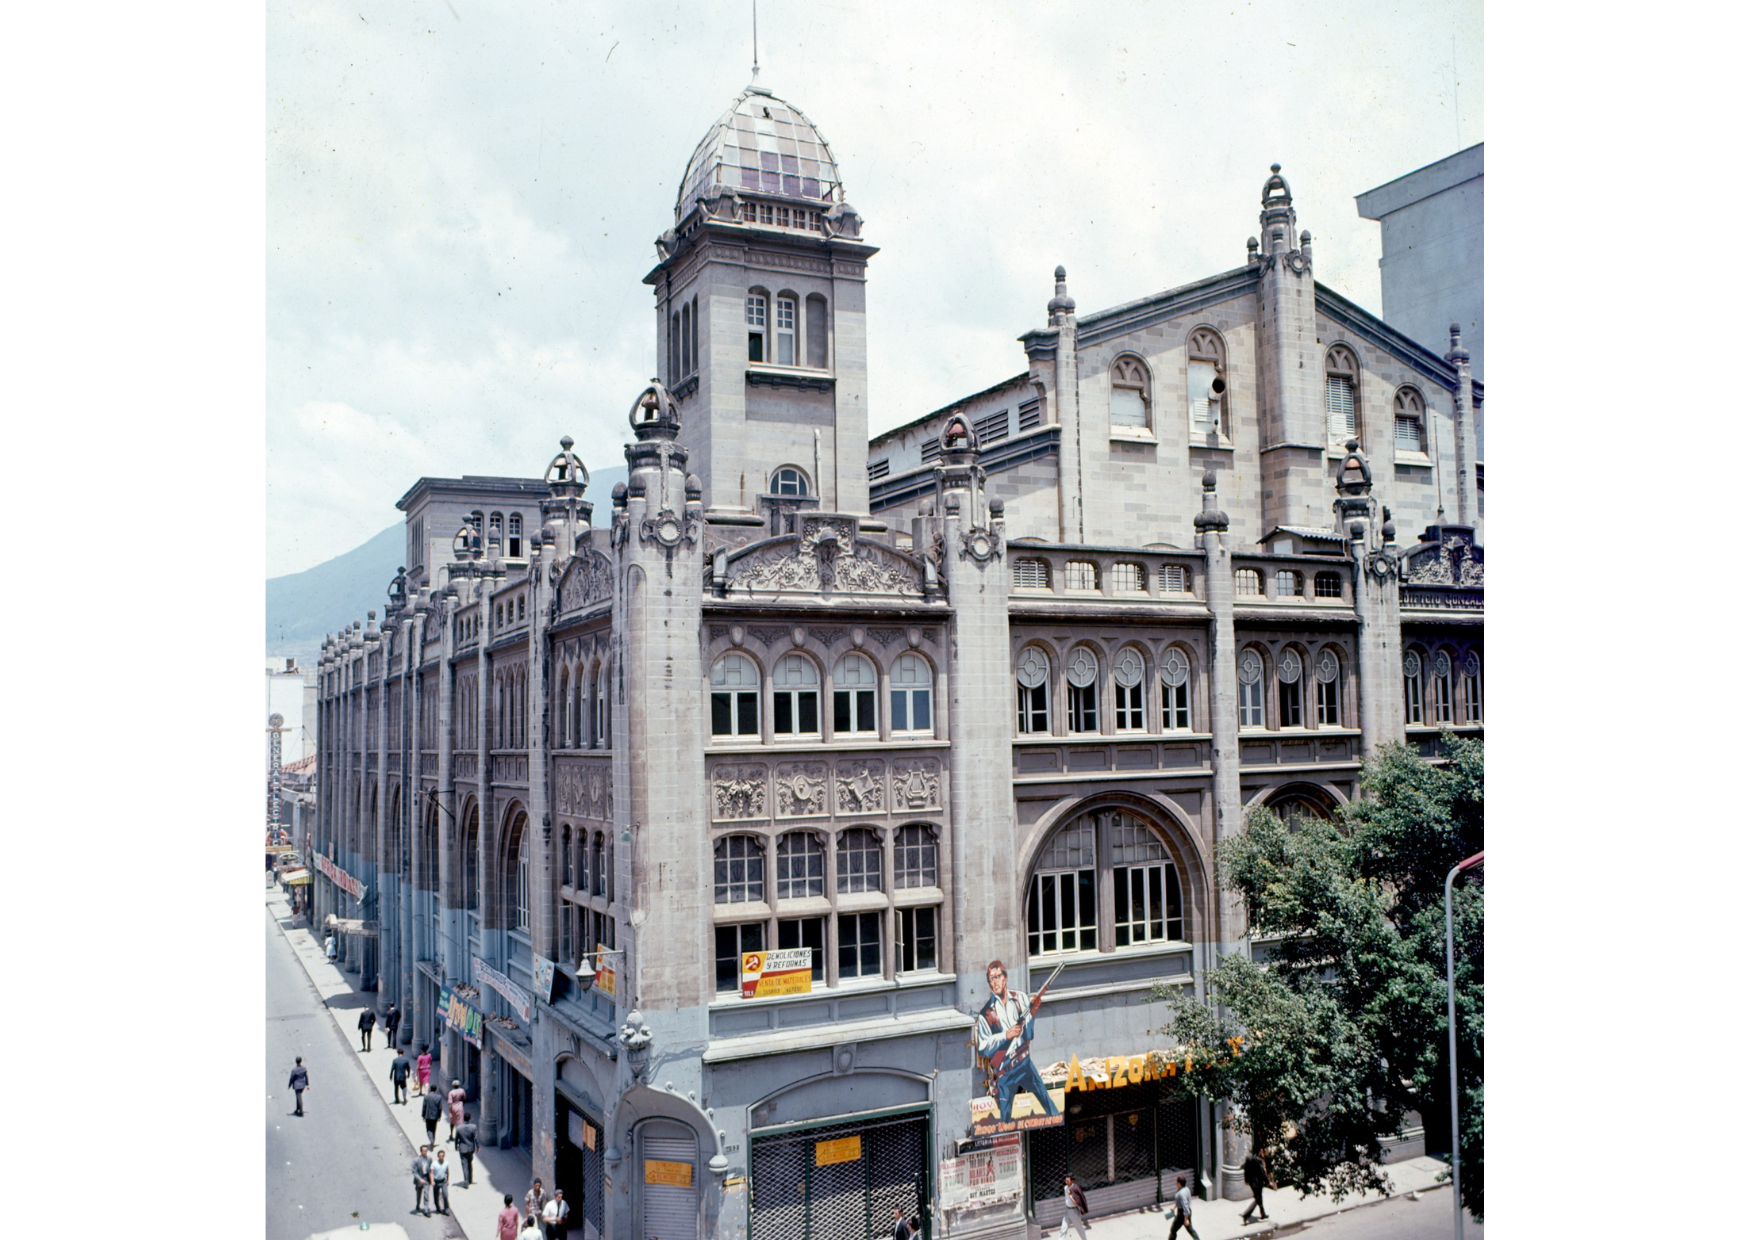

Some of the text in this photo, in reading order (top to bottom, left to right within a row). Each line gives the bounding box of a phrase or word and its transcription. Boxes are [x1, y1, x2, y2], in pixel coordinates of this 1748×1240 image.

[272, 732, 280, 785] GENERAL
[271, 786, 281, 847] ELECTRIC
[766, 950, 810, 960] DEMOLICIONES
[773, 959, 807, 968] REFORMAS
